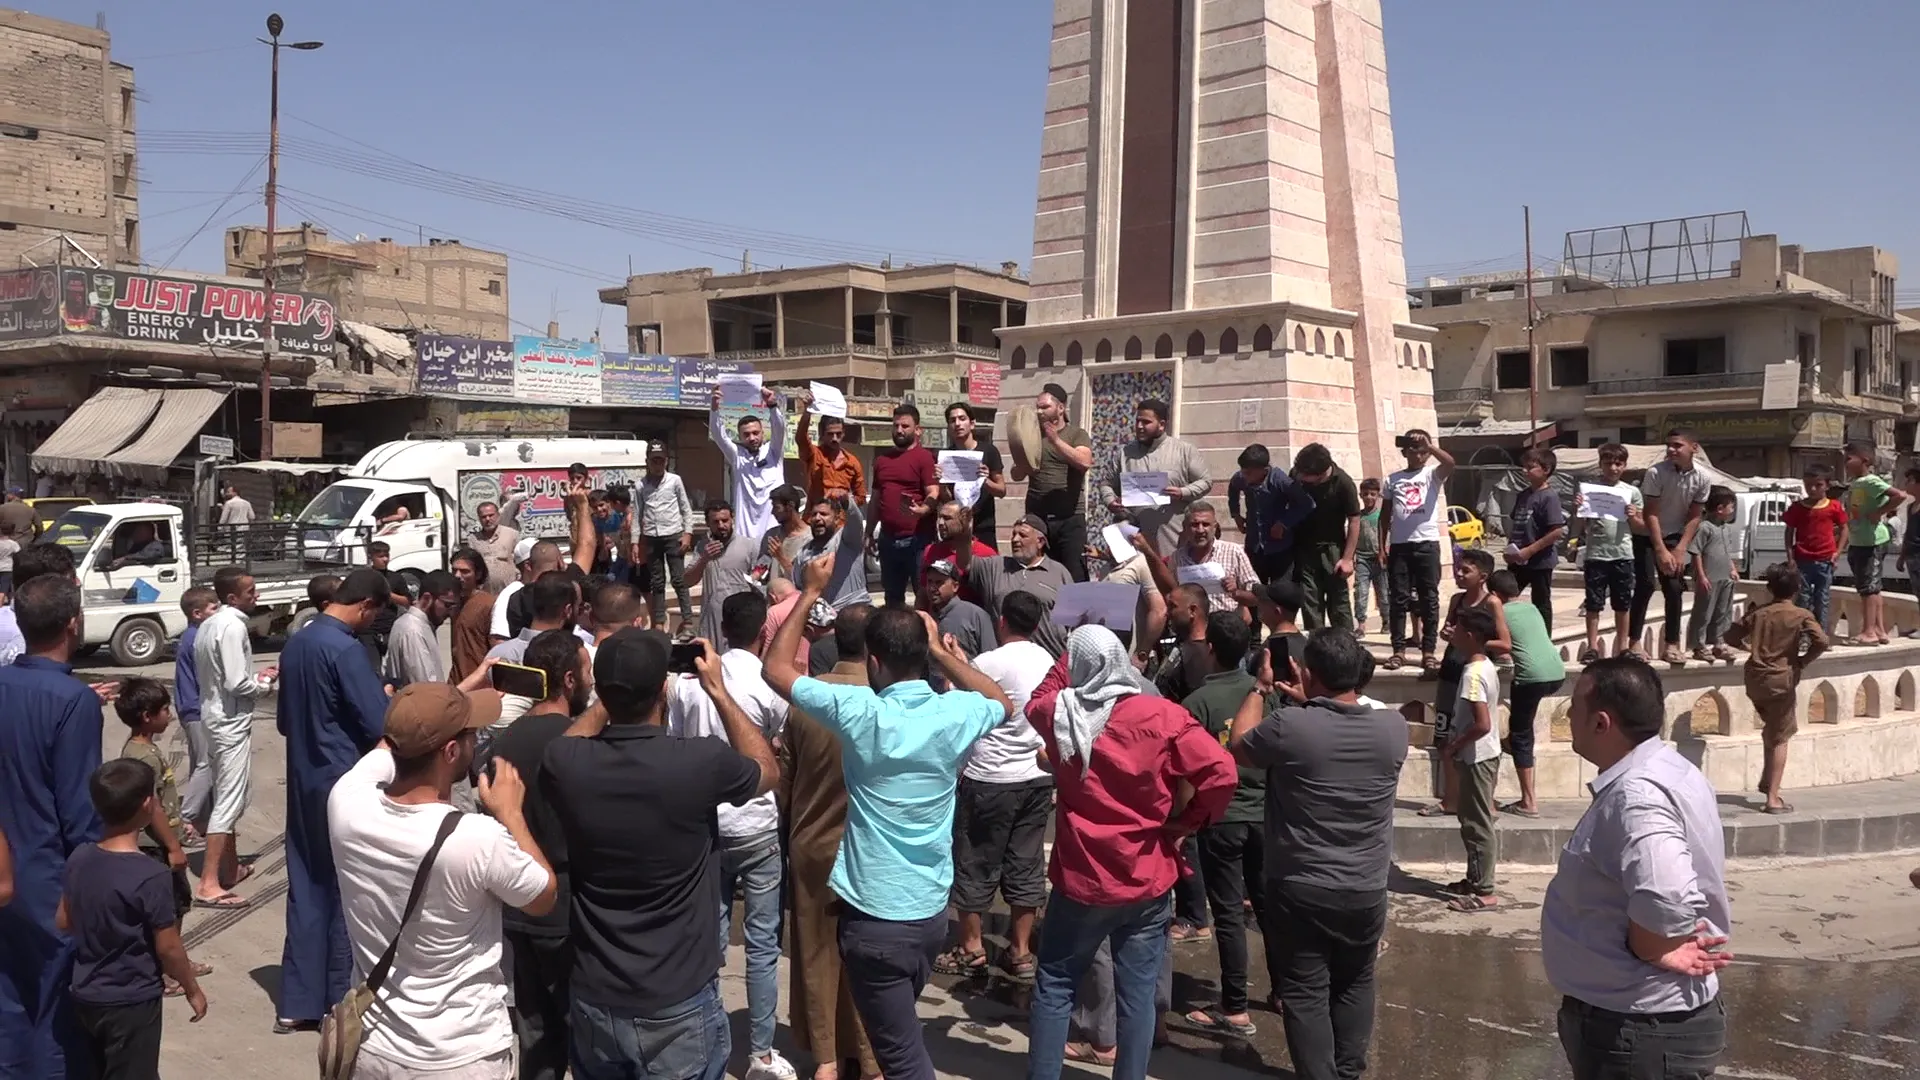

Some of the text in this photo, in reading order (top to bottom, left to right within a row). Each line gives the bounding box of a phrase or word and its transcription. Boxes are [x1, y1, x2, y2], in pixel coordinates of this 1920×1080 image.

[114, 276, 304, 326] JUST POWER
[127, 312, 196, 329] ENERGY
[128, 326, 180, 341] DRINK
[281, 337, 310, 351] ضيافة
[459, 344, 481, 364] ابن
[482, 345, 514, 365] مخبر
[479, 367, 514, 381] للتحاليل
